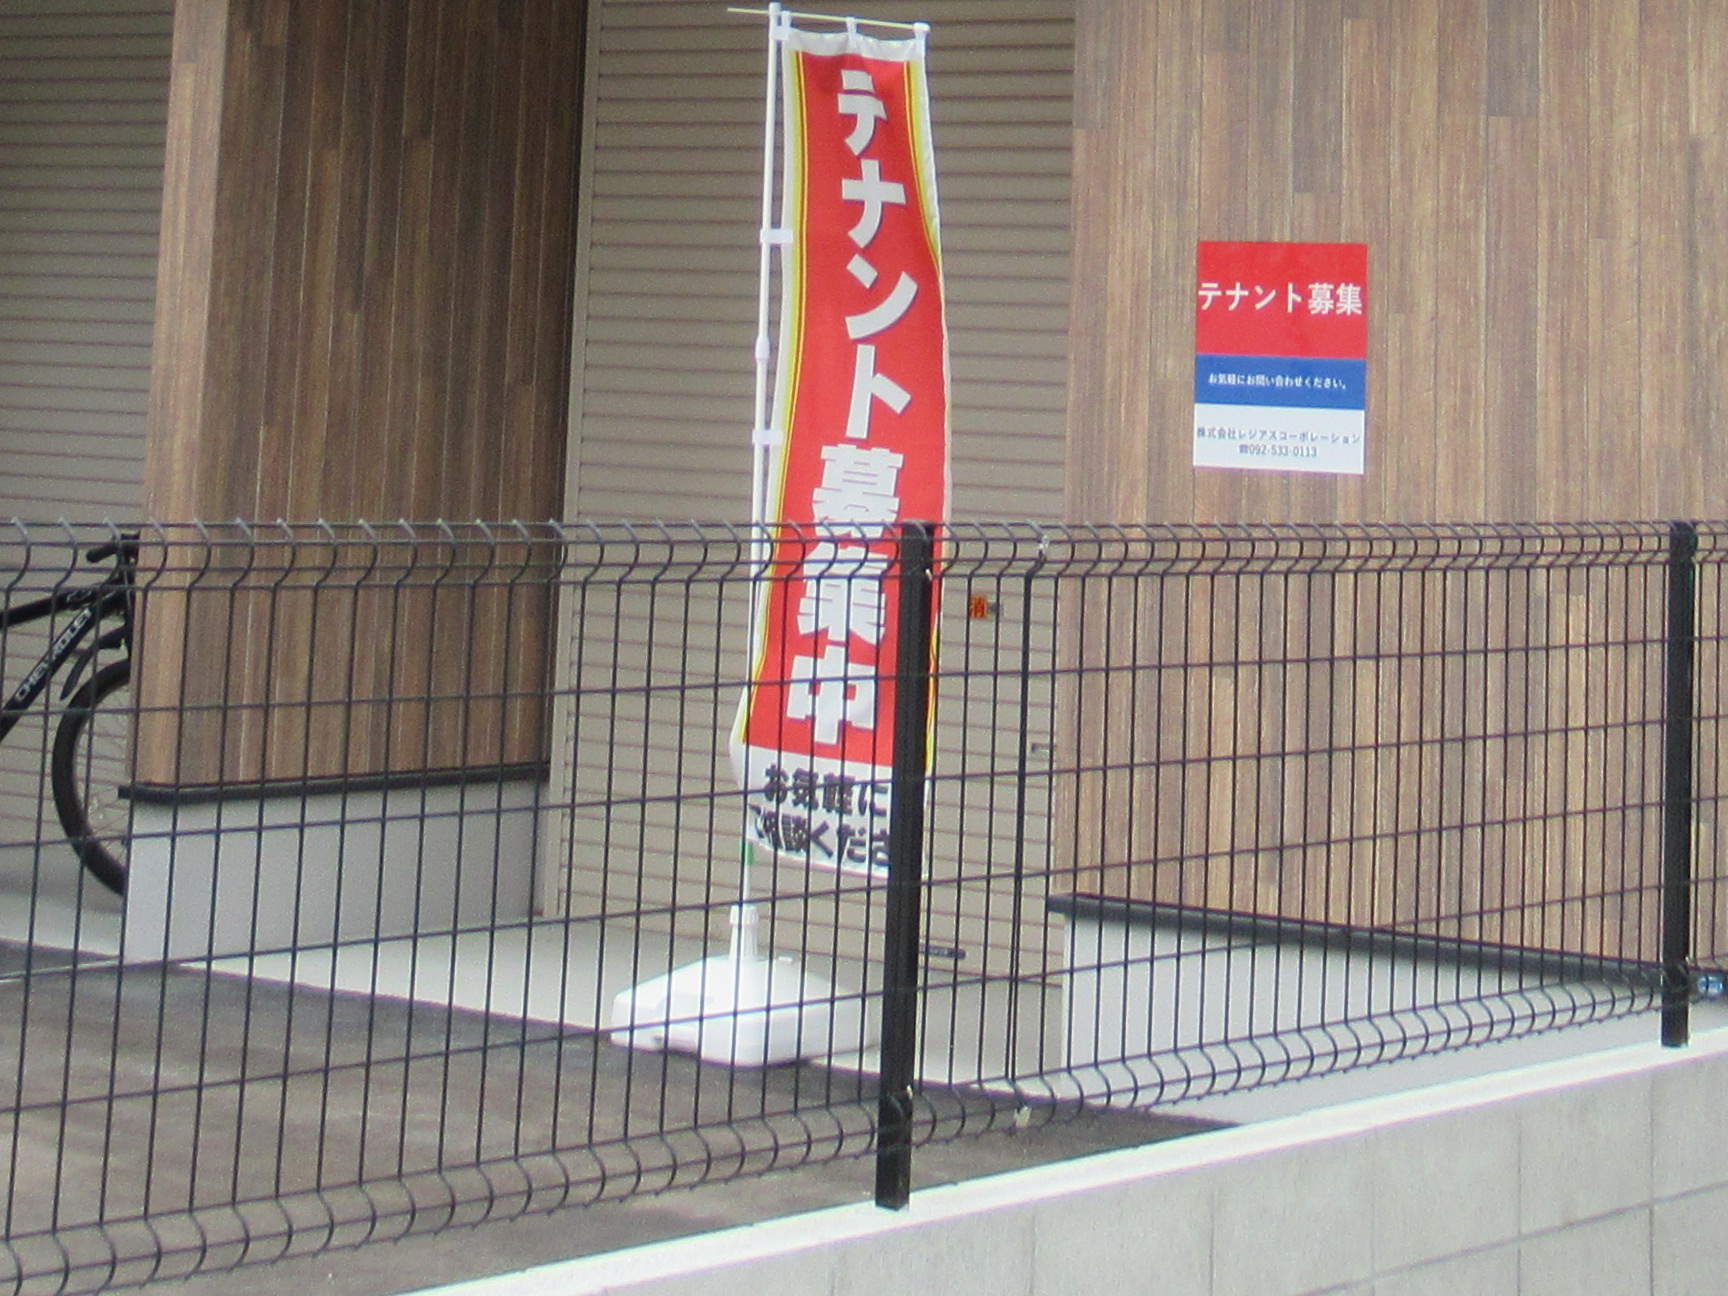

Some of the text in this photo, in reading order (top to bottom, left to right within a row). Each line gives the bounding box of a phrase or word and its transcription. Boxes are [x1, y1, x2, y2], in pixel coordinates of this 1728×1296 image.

[786, 69, 919, 746] テナント募集中
[1198, 282, 1363, 316] テナント募集
